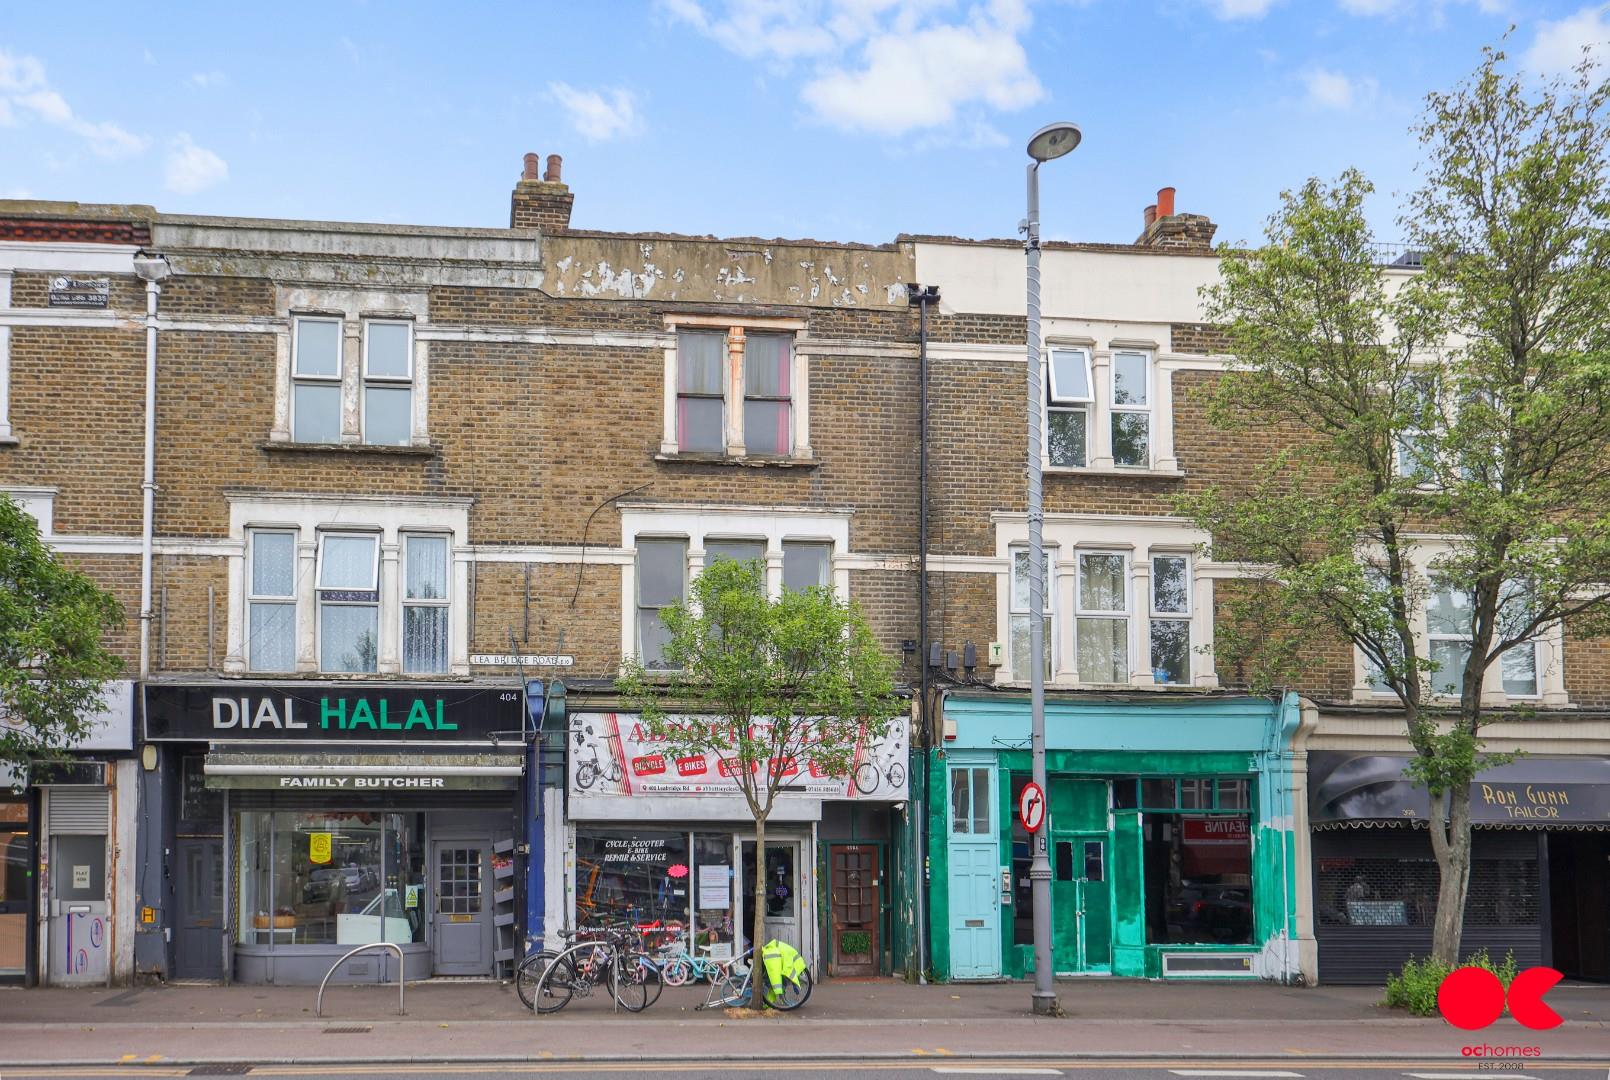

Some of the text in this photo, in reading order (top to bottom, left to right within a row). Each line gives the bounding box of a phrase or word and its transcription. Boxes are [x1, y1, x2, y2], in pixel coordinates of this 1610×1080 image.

[474, 655, 490, 664] LEA
[494, 656, 528, 664] BRIDGE
[532, 656, 558, 665] ROAD
[499, 692, 518, 701] 404
[212, 696, 458, 731] DIAL HALAL
[685, 760, 706, 771] BIKES
[279, 776, 444, 788] FAMILY BUTCHER
[1504, 806, 1560, 819] TAILOR
[604, 853, 629, 862] REPAIR
